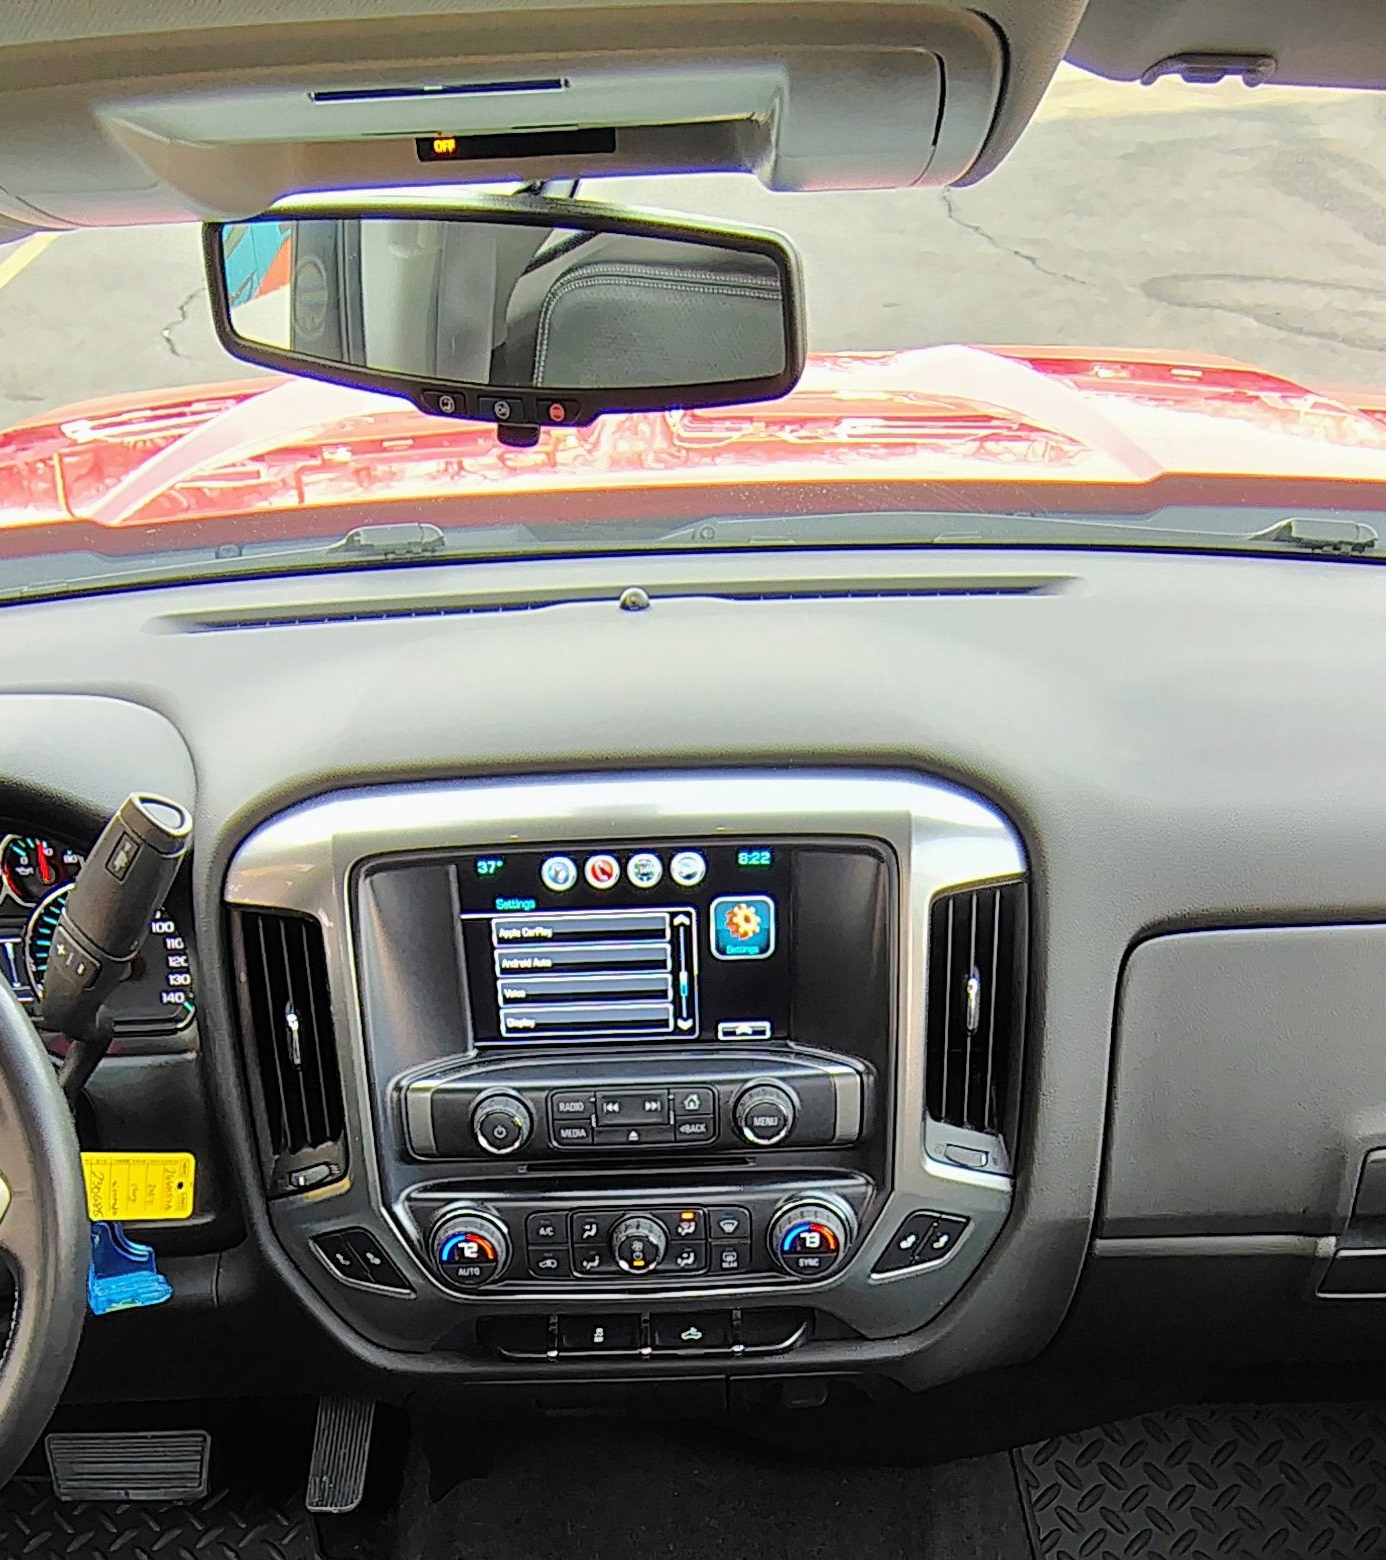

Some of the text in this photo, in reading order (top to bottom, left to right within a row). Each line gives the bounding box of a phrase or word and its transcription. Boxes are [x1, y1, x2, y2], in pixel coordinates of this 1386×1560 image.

[433, 139, 456, 154] OFF
[737, 851, 771, 865] 8:22
[476, 860, 503, 874] 37°
[495, 898, 537, 911] Settings
[151, 922, 175, 934] 100
[498, 926, 553, 939] Apple CarPlay
[501, 957, 553, 969] Android Auto
[167, 974, 192, 986] 130
[161, 991, 185, 1004] 140
[503, 988, 527, 999] Voice
[505, 1017, 536, 1029] Display
[558, 1101, 585, 1112] RADIO
[753, 1116, 778, 1127] MENU
[560, 1128, 588, 1138] MEDIA
[683, 1122, 708, 1134] BACK
[538, 1226, 555, 1237] A/C
[457, 1241, 480, 1259] 72
[798, 1257, 821, 1268] SYNC
[457, 1267, 481, 1276] AUTO
